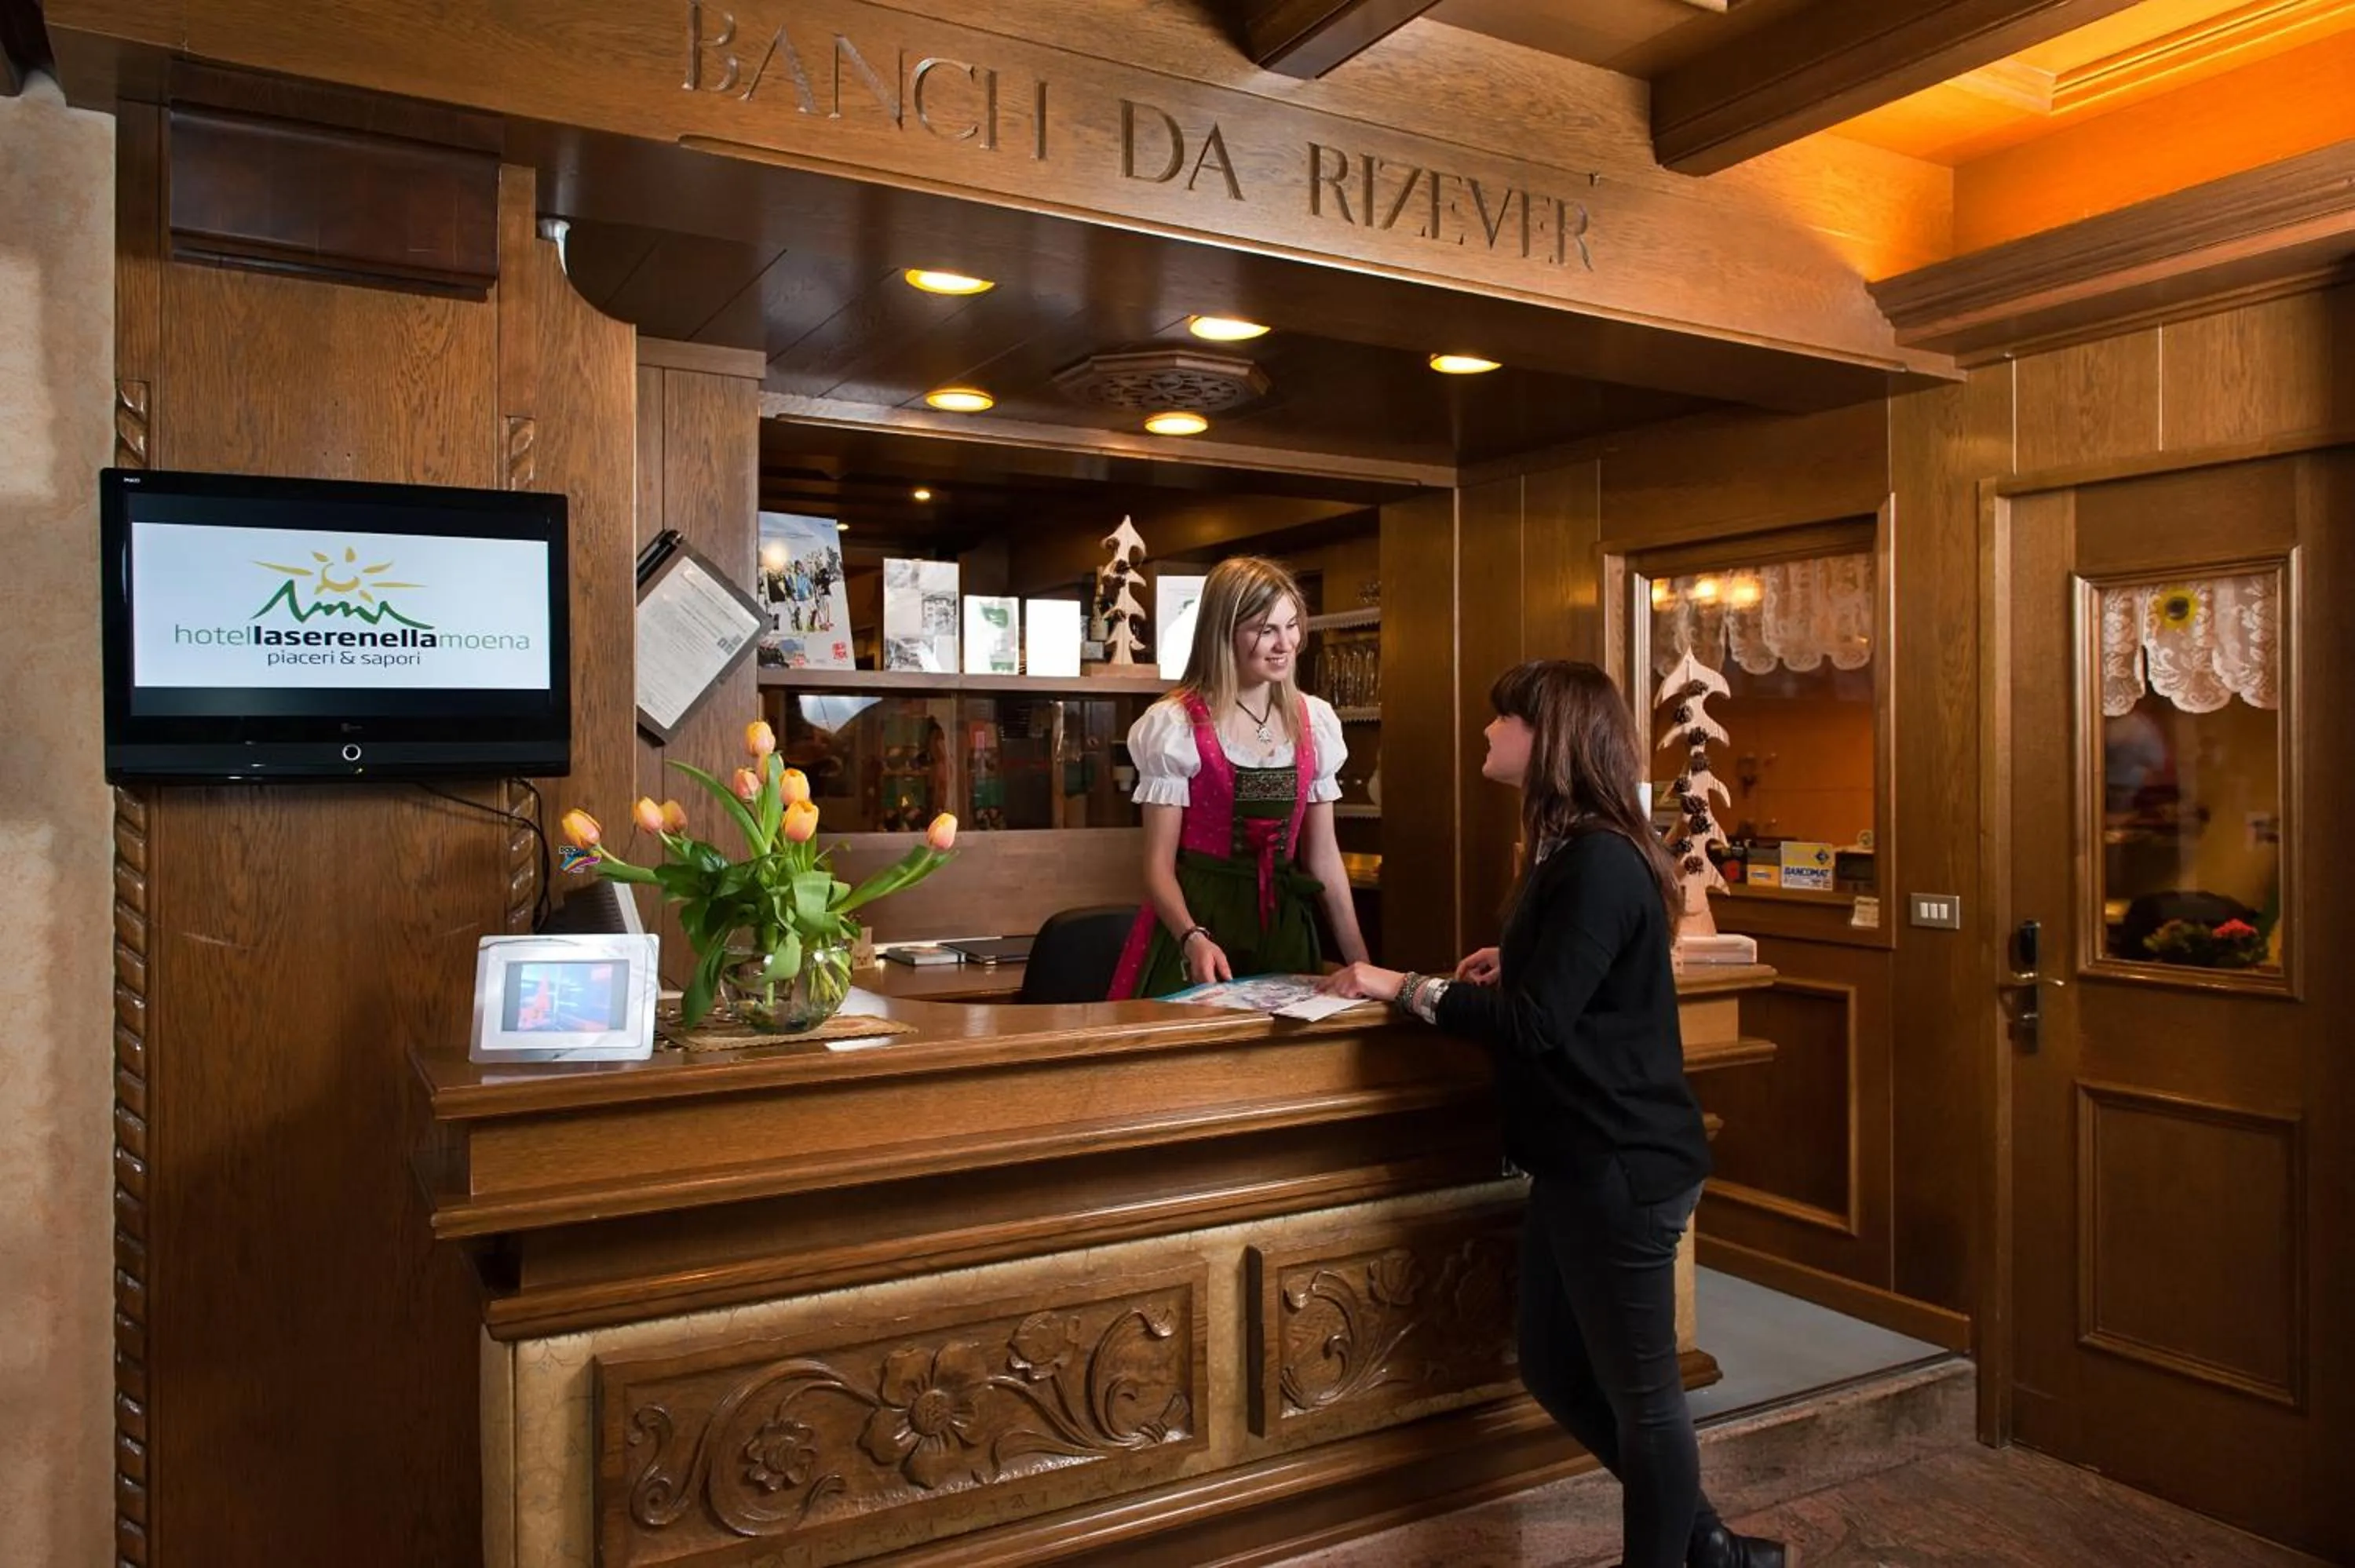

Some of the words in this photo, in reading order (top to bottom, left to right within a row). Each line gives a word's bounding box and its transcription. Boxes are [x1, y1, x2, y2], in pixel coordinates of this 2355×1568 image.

[1118, 98, 1246, 202] DA
[1307, 141, 1594, 272] RIZEVER
[267, 650, 334, 666] piaceri
[340, 651, 356, 665] &
[360, 651, 422, 669] sapori
